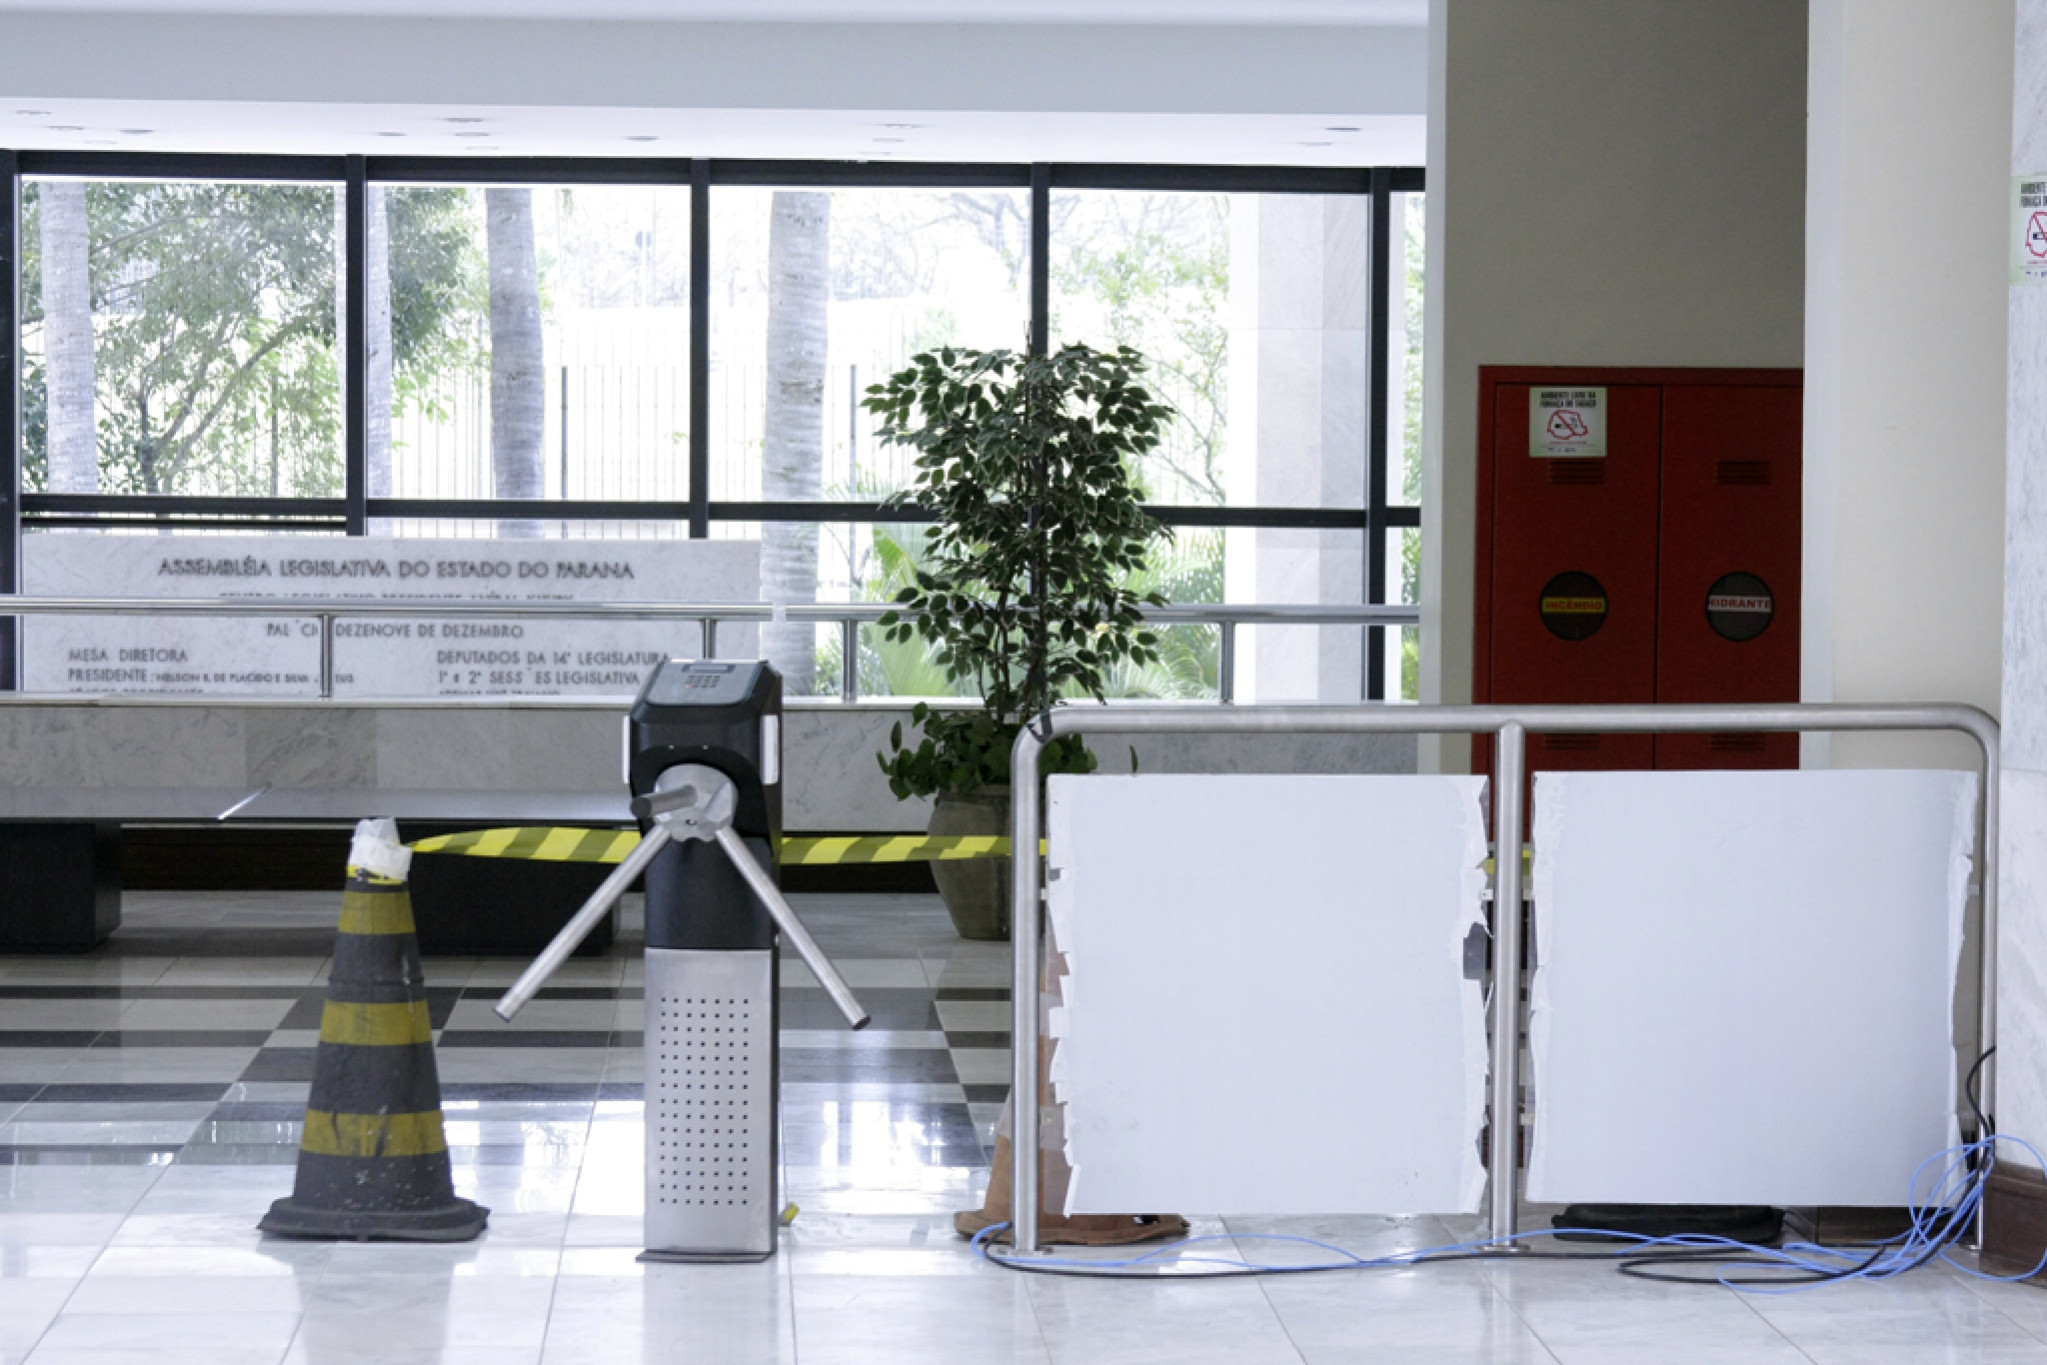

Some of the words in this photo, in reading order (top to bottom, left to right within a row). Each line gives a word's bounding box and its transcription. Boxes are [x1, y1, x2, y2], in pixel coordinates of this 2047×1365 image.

[158, 554, 272, 577] ASSEMBLÉIA
[279, 559, 390, 577] LEGISLATIVA
[398, 560, 429, 578] DO
[437, 560, 511, 578] ESTADO
[518, 560, 549, 579] DO
[335, 623, 411, 638] DEZENOVE
[417, 624, 436, 638] DE
[442, 624, 525, 639] DEZEMBRO
[67, 647, 109, 662] MESA
[119, 648, 189, 662] DIRETORA
[437, 650, 521, 665] DEPUTADOS
[526, 651, 546, 665] DA
[577, 651, 669, 666] LEGISLATURA
[555, 670, 641, 685] LEGISLATIVA
